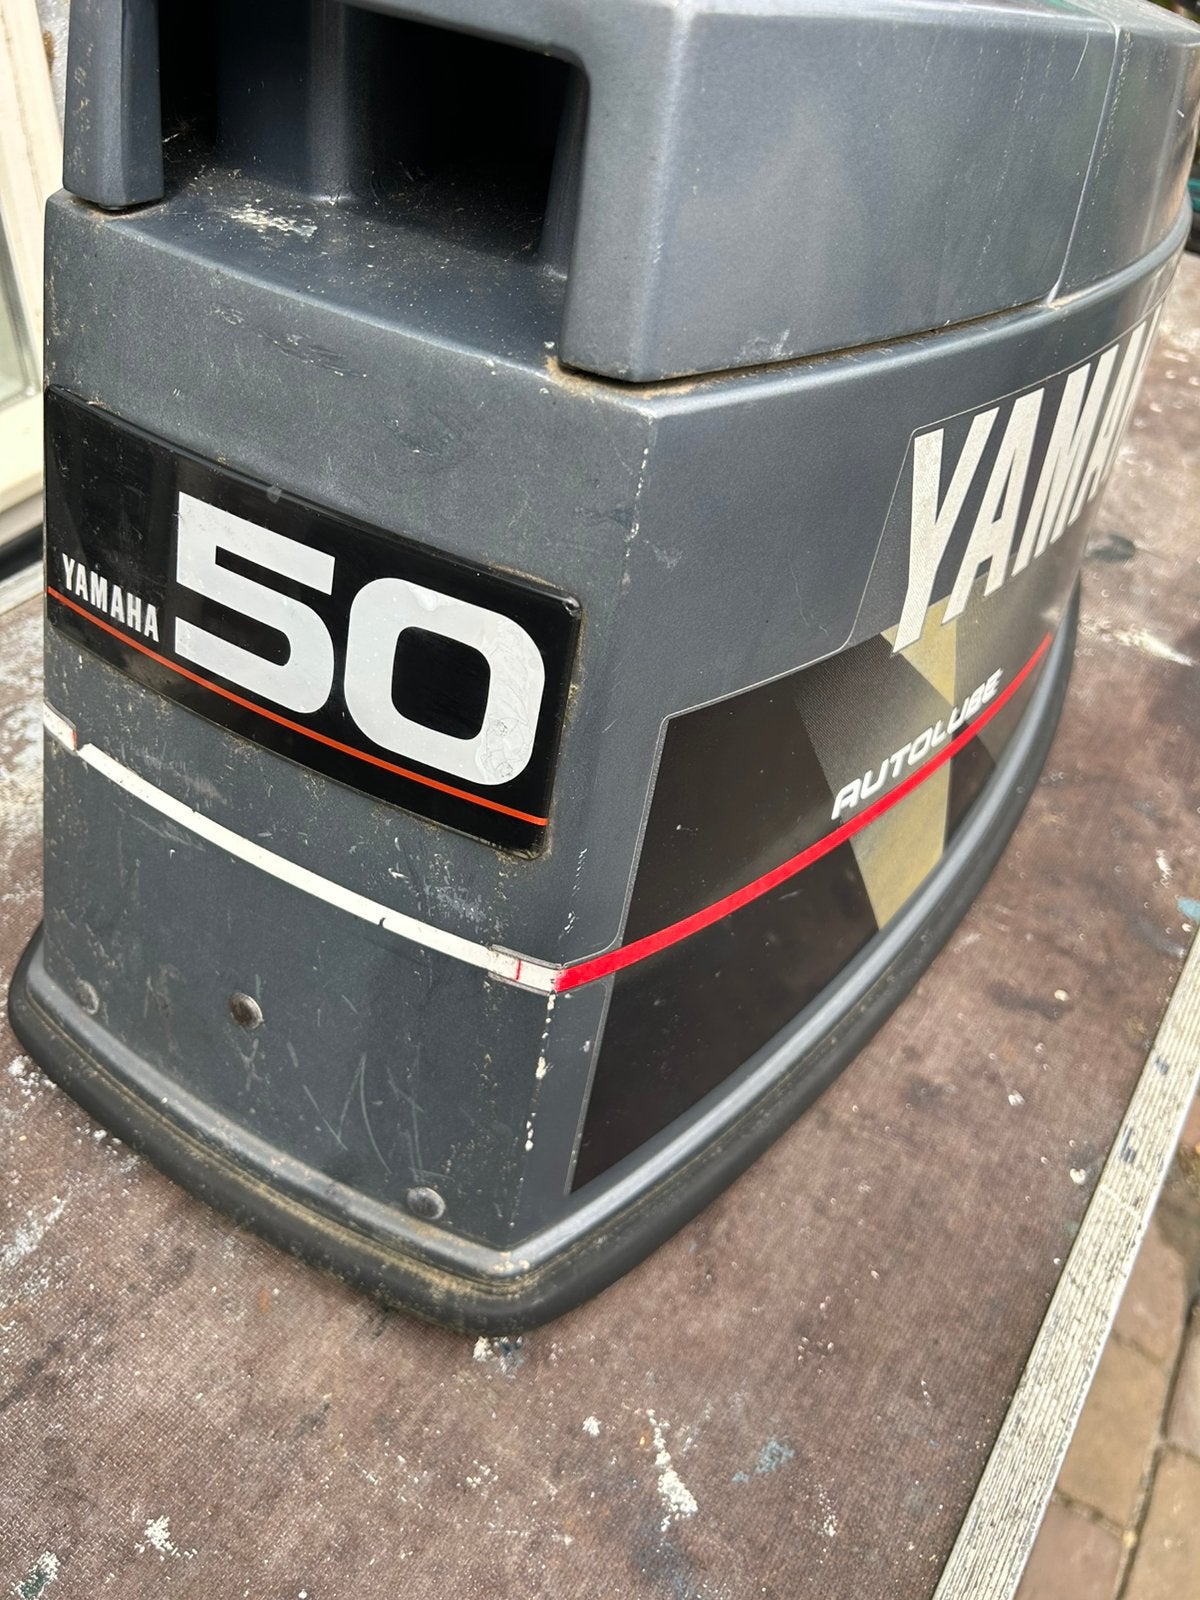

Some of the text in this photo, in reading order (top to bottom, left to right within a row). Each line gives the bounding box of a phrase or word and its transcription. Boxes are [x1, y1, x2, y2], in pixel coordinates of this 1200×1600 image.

[62, 552, 160, 643] YAMAHA
[175, 491, 546, 786] 50
[831, 667, 1004, 821] AUTOLUBE
